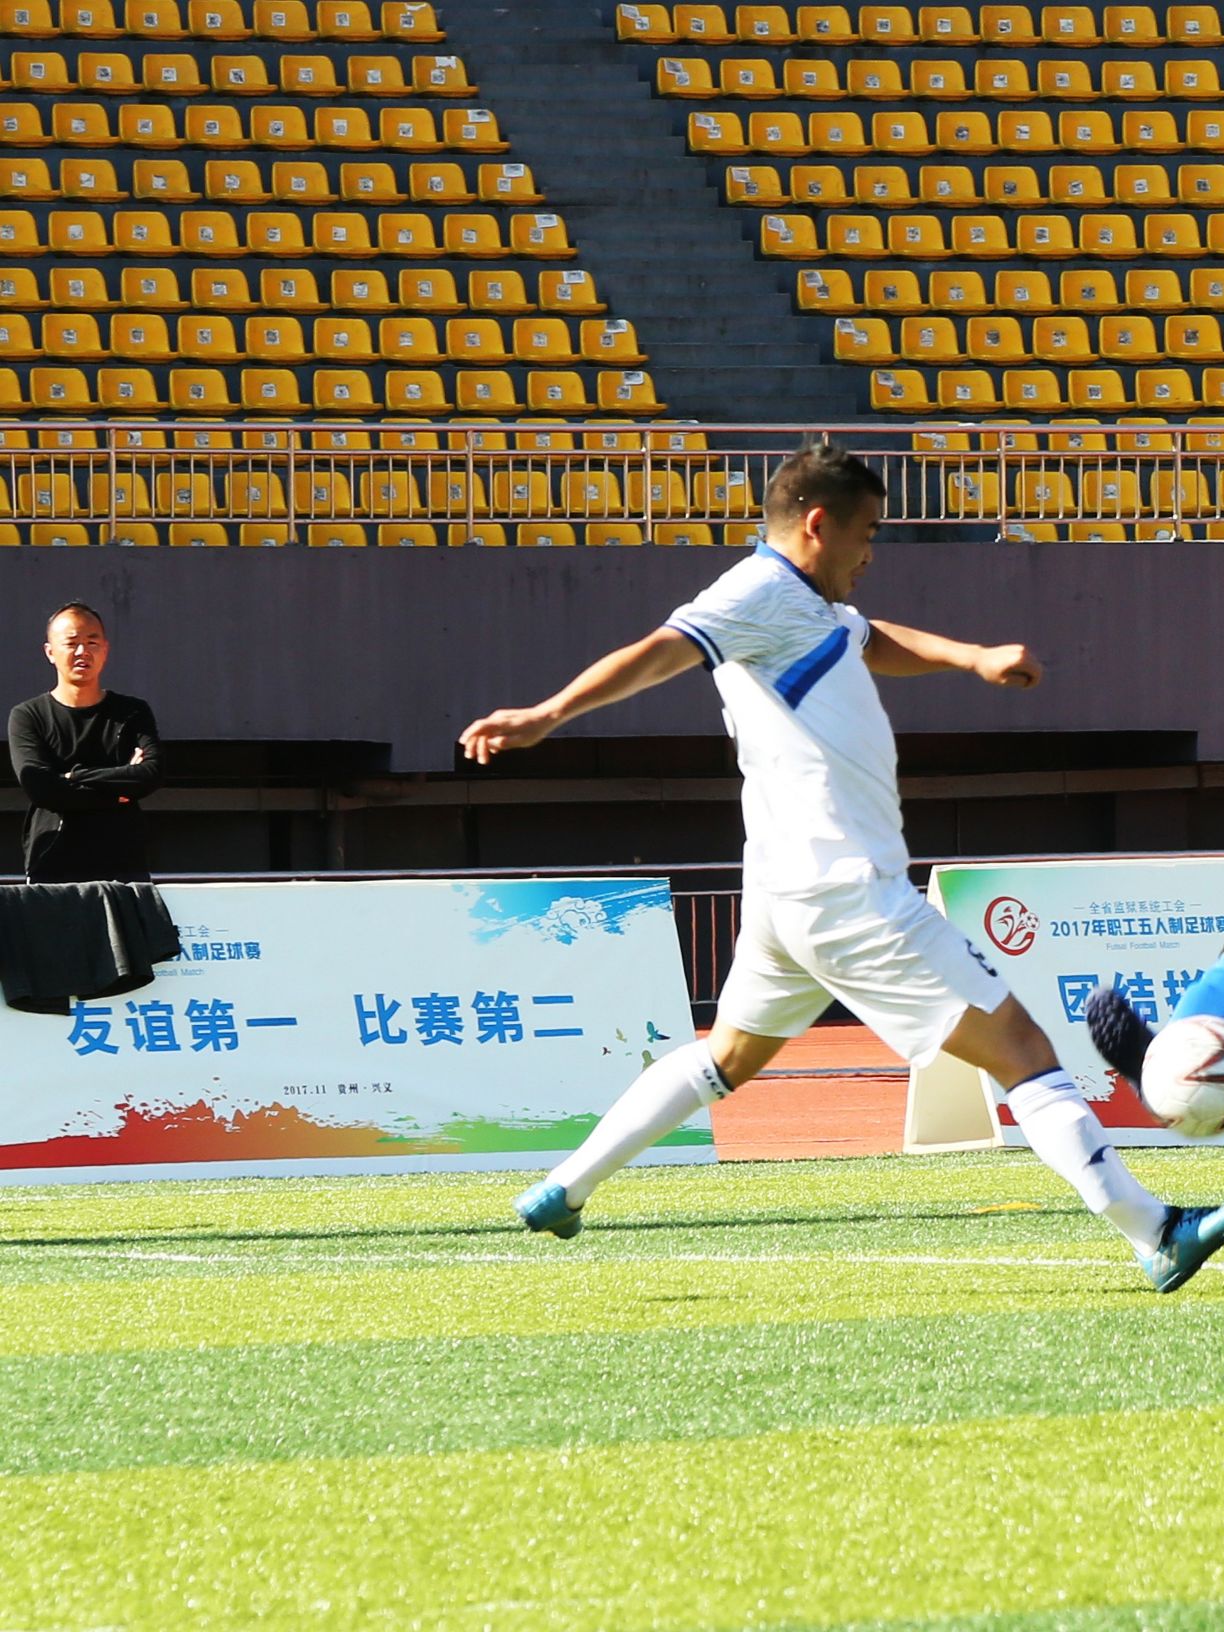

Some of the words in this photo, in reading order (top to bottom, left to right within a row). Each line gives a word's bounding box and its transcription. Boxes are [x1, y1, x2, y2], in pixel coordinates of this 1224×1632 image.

[1089, 900, 1185, 915] 全省监狱系统工会
[165, 941, 261, 961] 人制足球赛
[66, 998, 298, 1056] 友谊第一
[353, 990, 584, 1047] 比赛第二
[283, 1084, 327, 1096] 2017.11
